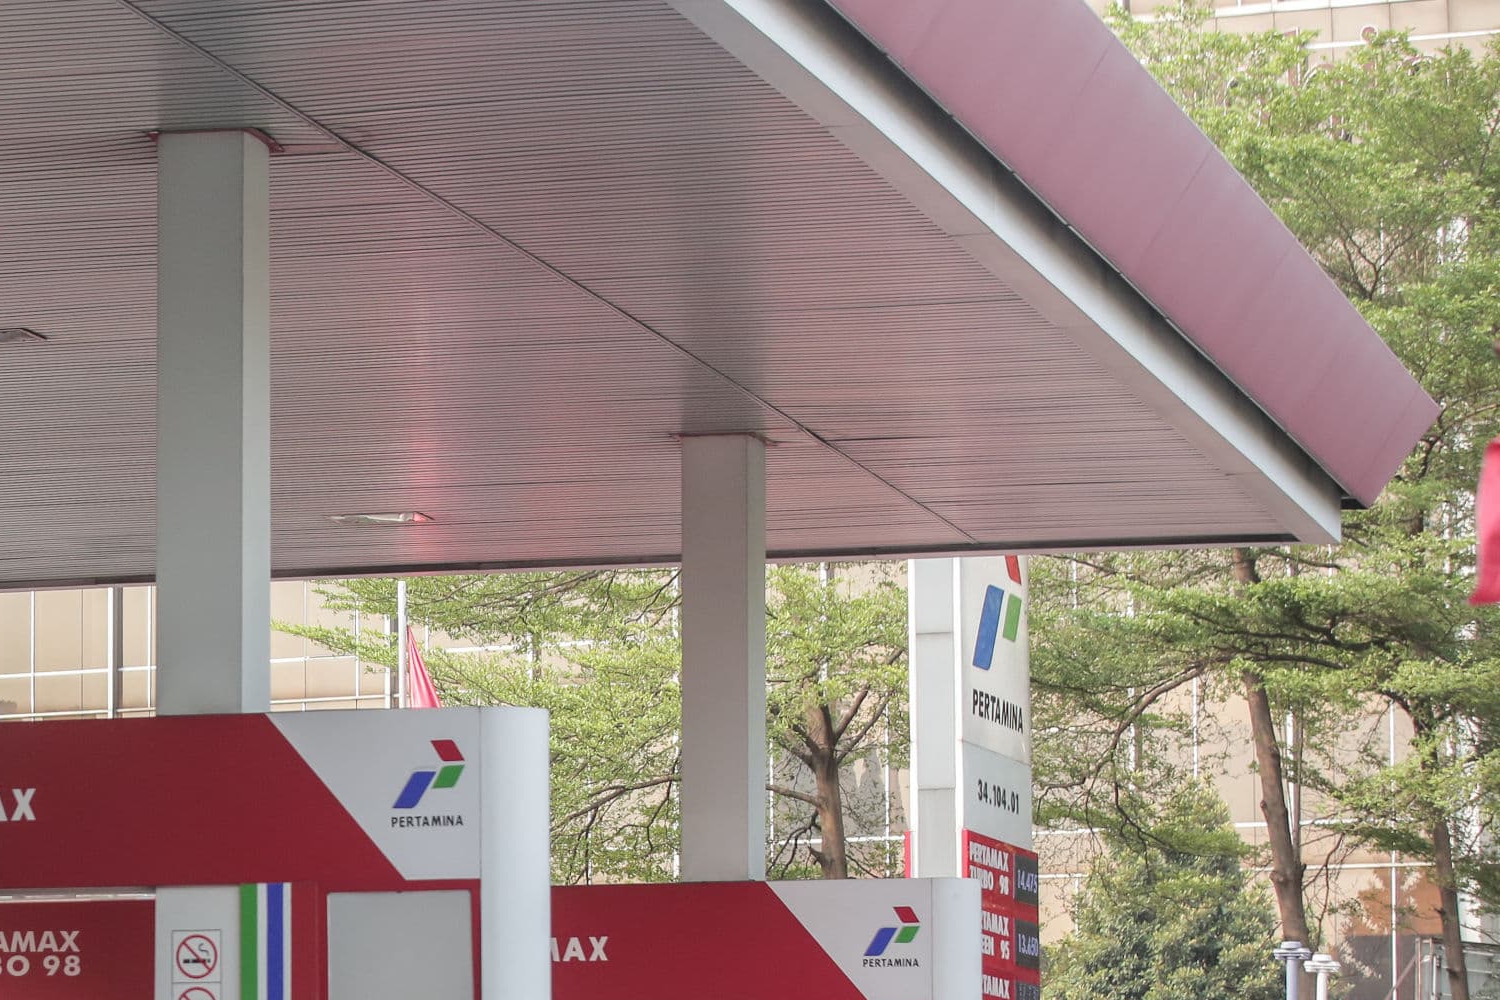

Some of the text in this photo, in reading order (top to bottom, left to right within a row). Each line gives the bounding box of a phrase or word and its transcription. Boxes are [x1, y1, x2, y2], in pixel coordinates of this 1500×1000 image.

[972, 688, 1024, 734] PERTAMINA
[978, 778, 1019, 814] 34.104.01
[391, 814, 465, 828] PERTAMINA
[969, 840, 1038, 894] PERTAMAX 14.475
[999, 875, 1009, 895] 98
[981, 910, 1010, 937] TAMAX
[1000, 940, 1010, 960] 95
[43, 956, 81, 977] 98
[862, 958, 920, 968] PERTAMINA
[982, 975, 1010, 999] TAMAX
